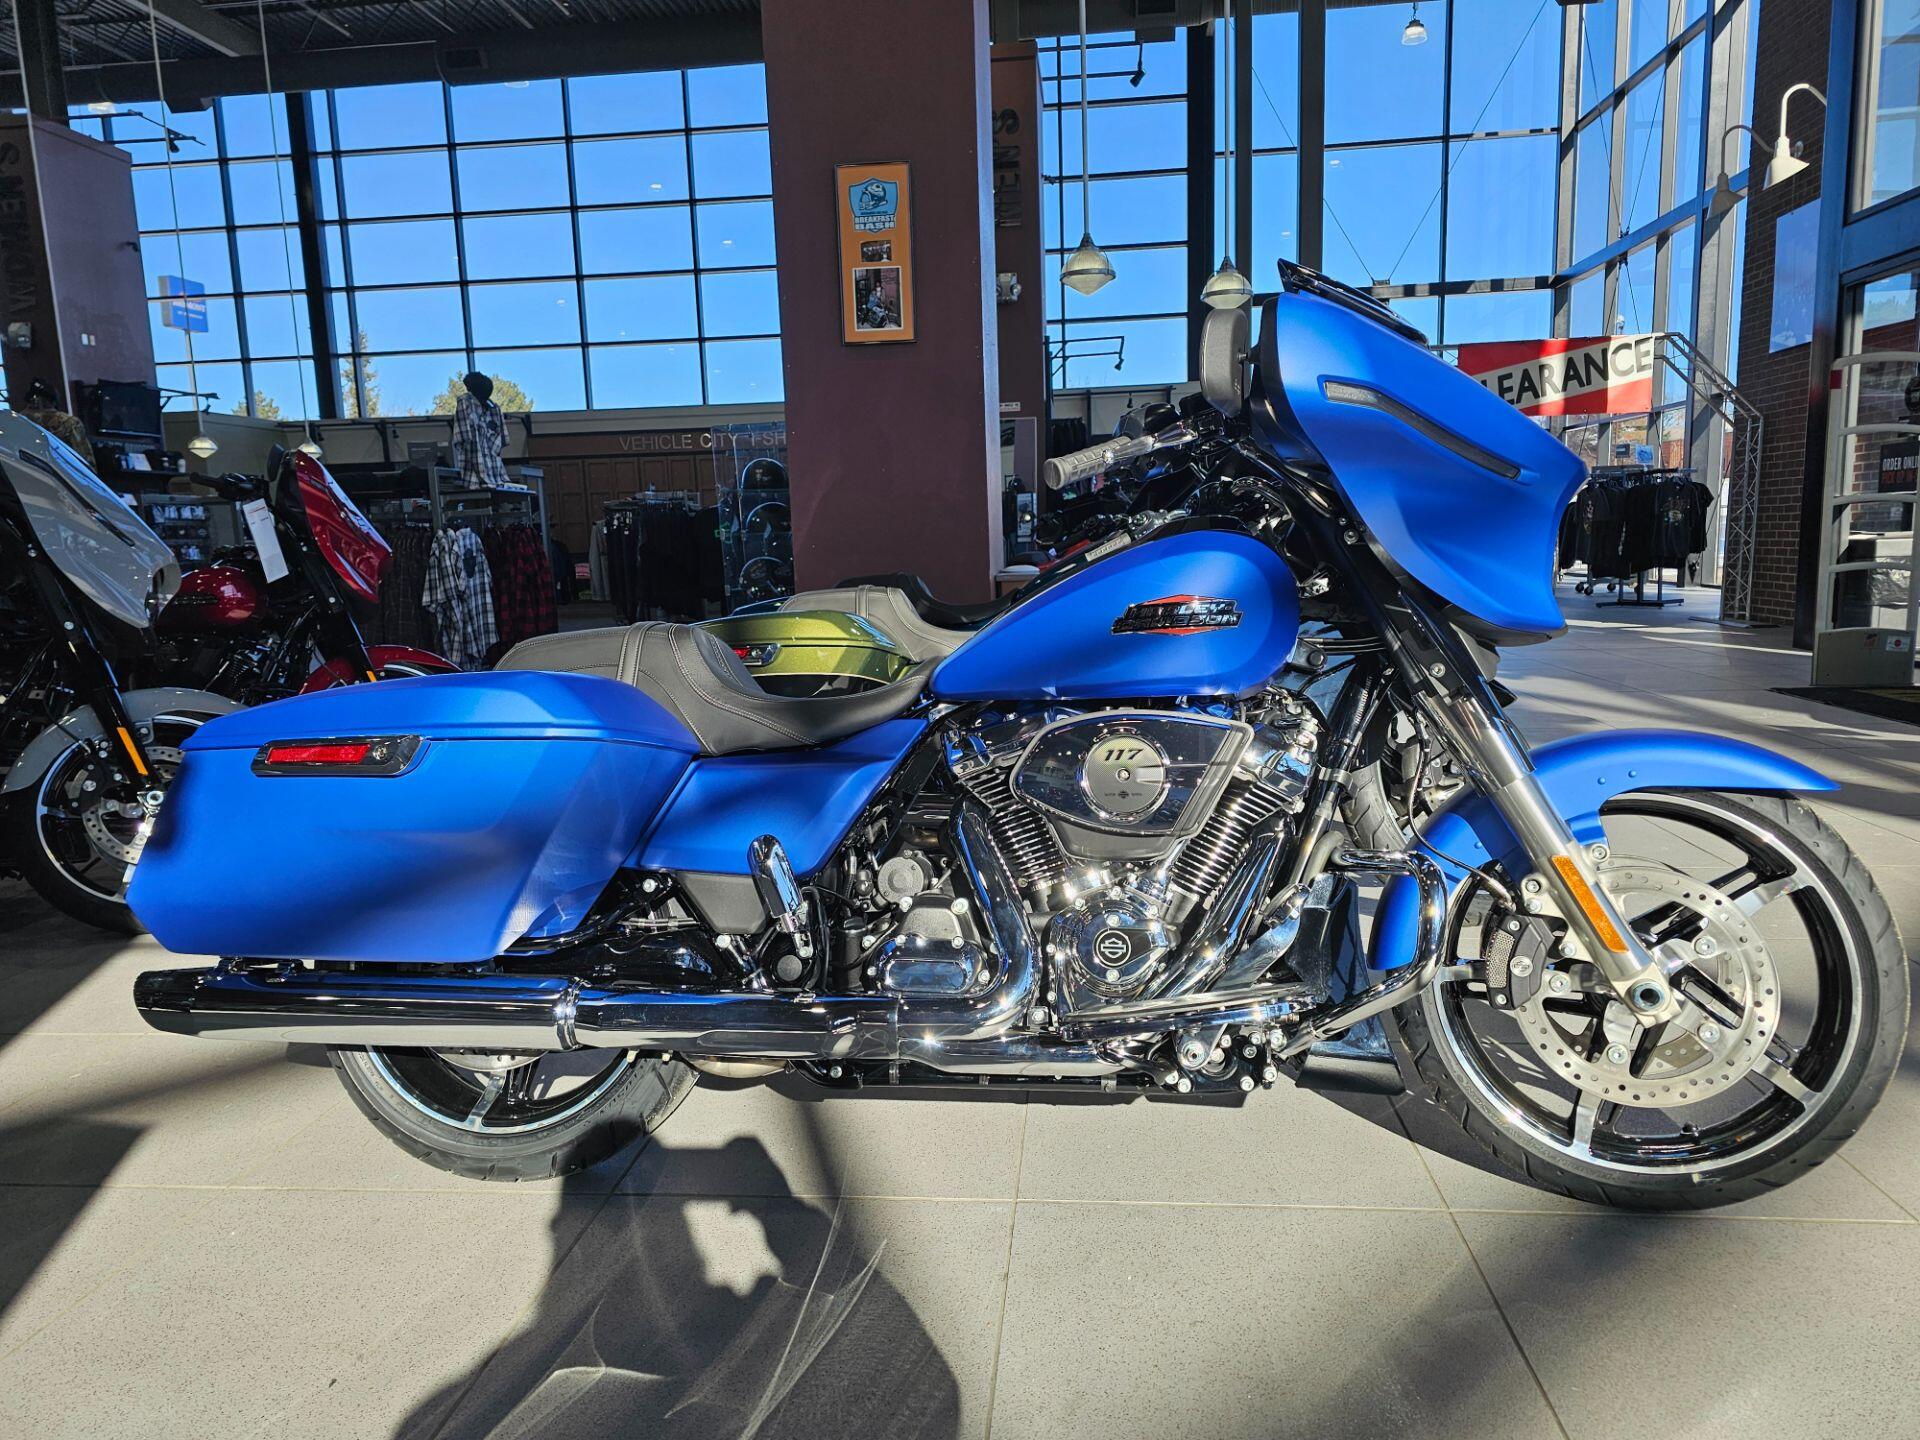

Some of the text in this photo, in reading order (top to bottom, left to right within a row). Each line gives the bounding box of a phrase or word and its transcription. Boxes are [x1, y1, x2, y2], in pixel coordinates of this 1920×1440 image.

[854, 215, 896, 223] BREAKFAST
[854, 221, 896, 230] BASH
[619, 434, 692, 450] VEHICLE
[700, 433, 737, 448] CITY
[1882, 457, 1902, 471] ORDER
[1105, 749, 1143, 761] 117
